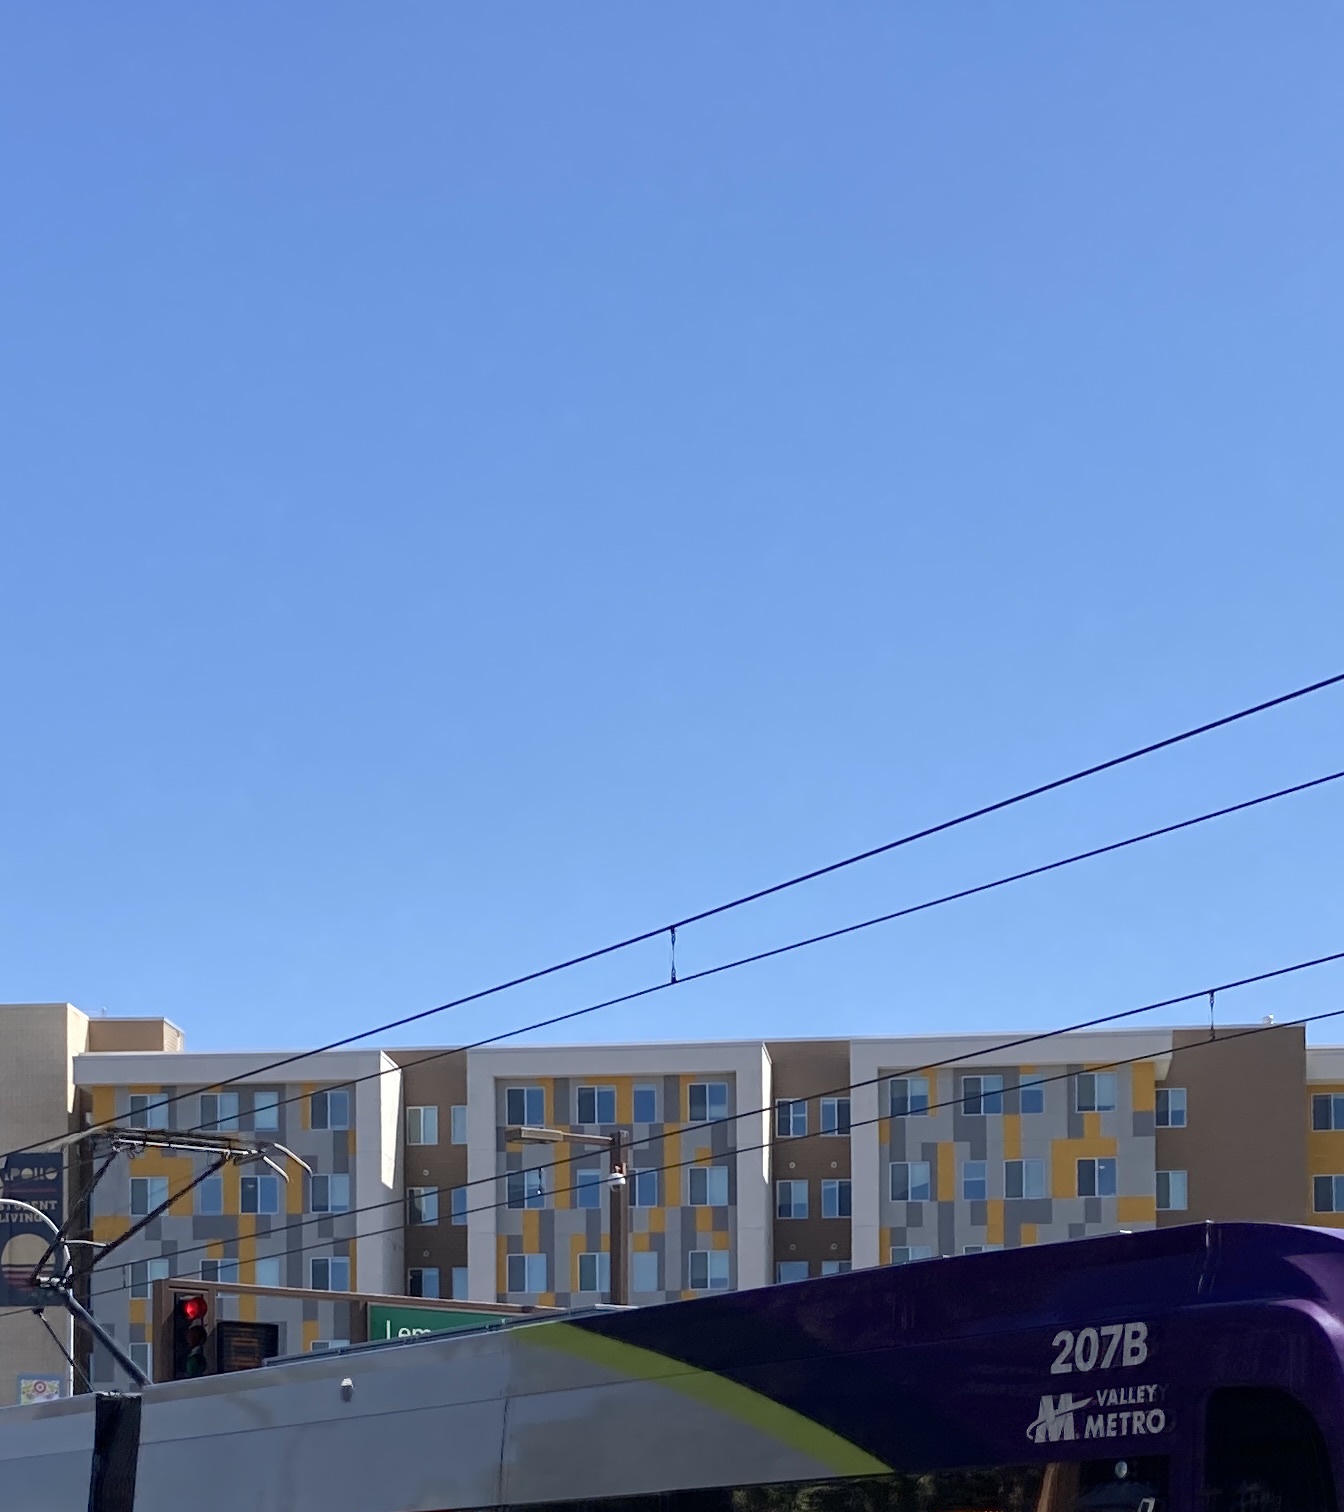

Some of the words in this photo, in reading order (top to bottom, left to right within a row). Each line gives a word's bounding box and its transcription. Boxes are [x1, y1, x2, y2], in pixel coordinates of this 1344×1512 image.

[1050, 1321, 1149, 1375] 207B
[1095, 1383, 1159, 1407] VALLEY
[1084, 1408, 1166, 1439] METRO
